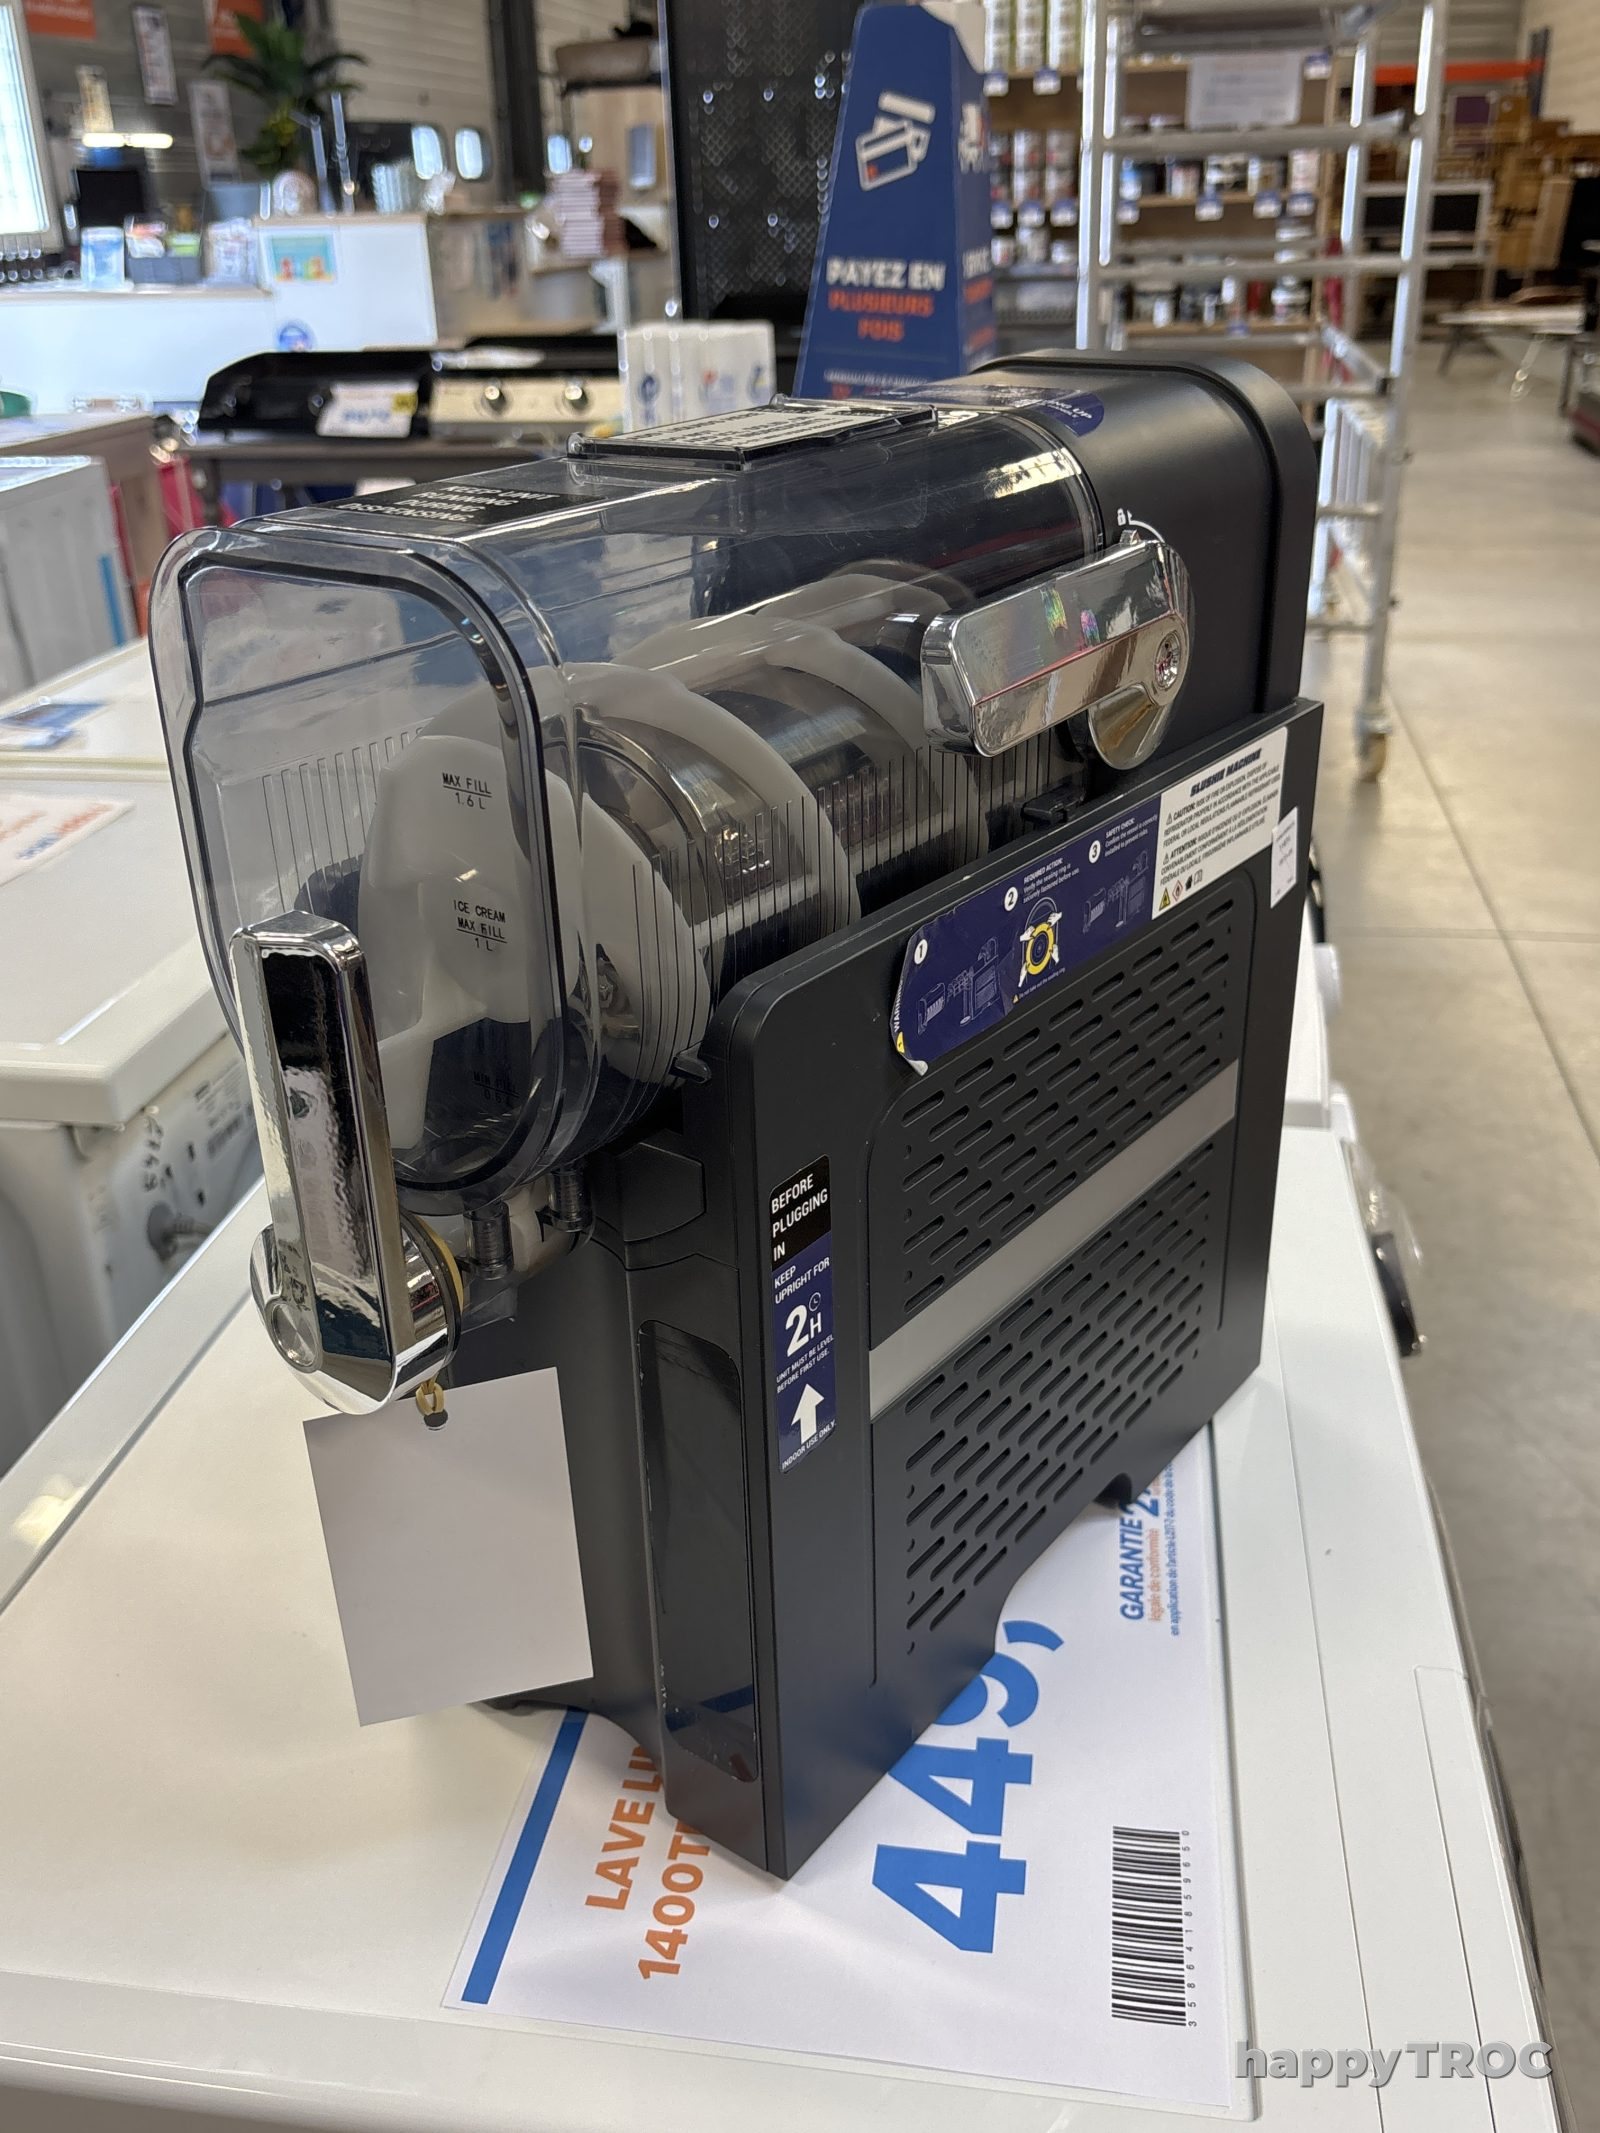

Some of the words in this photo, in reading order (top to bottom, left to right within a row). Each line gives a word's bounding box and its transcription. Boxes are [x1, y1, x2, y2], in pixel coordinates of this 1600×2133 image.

[826, 256, 907, 289] PAYEZ
[908, 260, 946, 291] EN
[827, 288, 935, 318] PLUSIEURS
[411, 491, 520, 507] RUNNING
[439, 485, 501, 495] KEEP
[393, 499, 486, 513] DURING
[442, 772, 461, 788] MAX
[466, 778, 492, 795] FILL
[455, 792, 475, 808] 1.6
[478, 797, 486, 810] L
[1092, 844, 1098, 859] 3
[1007, 891, 1015, 906] 2
[453, 899, 471, 914] ICE
[475, 905, 506, 924] CREAM
[457, 917, 476, 932] MAX
[480, 923, 505, 940] FILL
[475, 937, 480, 948] 1
[485, 940, 493, 951] L
[771, 1173, 814, 1214] BEFORE
[772, 1188, 829, 1238] PLUGGING
[773, 1241, 786, 1262] IN
[774, 1265, 797, 1289] KEEP
[775, 1269, 813, 1304] UPRIGHT
[813, 1257, 830, 1277] FOR
[776, 1367, 791, 1383] UNIT
[791, 1354, 808, 1373] MUST
[808, 1346, 817, 1360] BE
[817, 1333, 835, 1352] LEVEL
[776, 1372, 800, 1394] BEFORE
[799, 1357, 817, 1377] FIRST
[817, 1347, 831, 1361] USE.
[781, 1444, 806, 1470] INDOOR
[806, 1436, 819, 1450] USE
[1119, 1517, 1144, 1621] GARANTIE
[1169, 1624, 1179, 1636] en
[585, 1799, 655, 1910] LAVE
